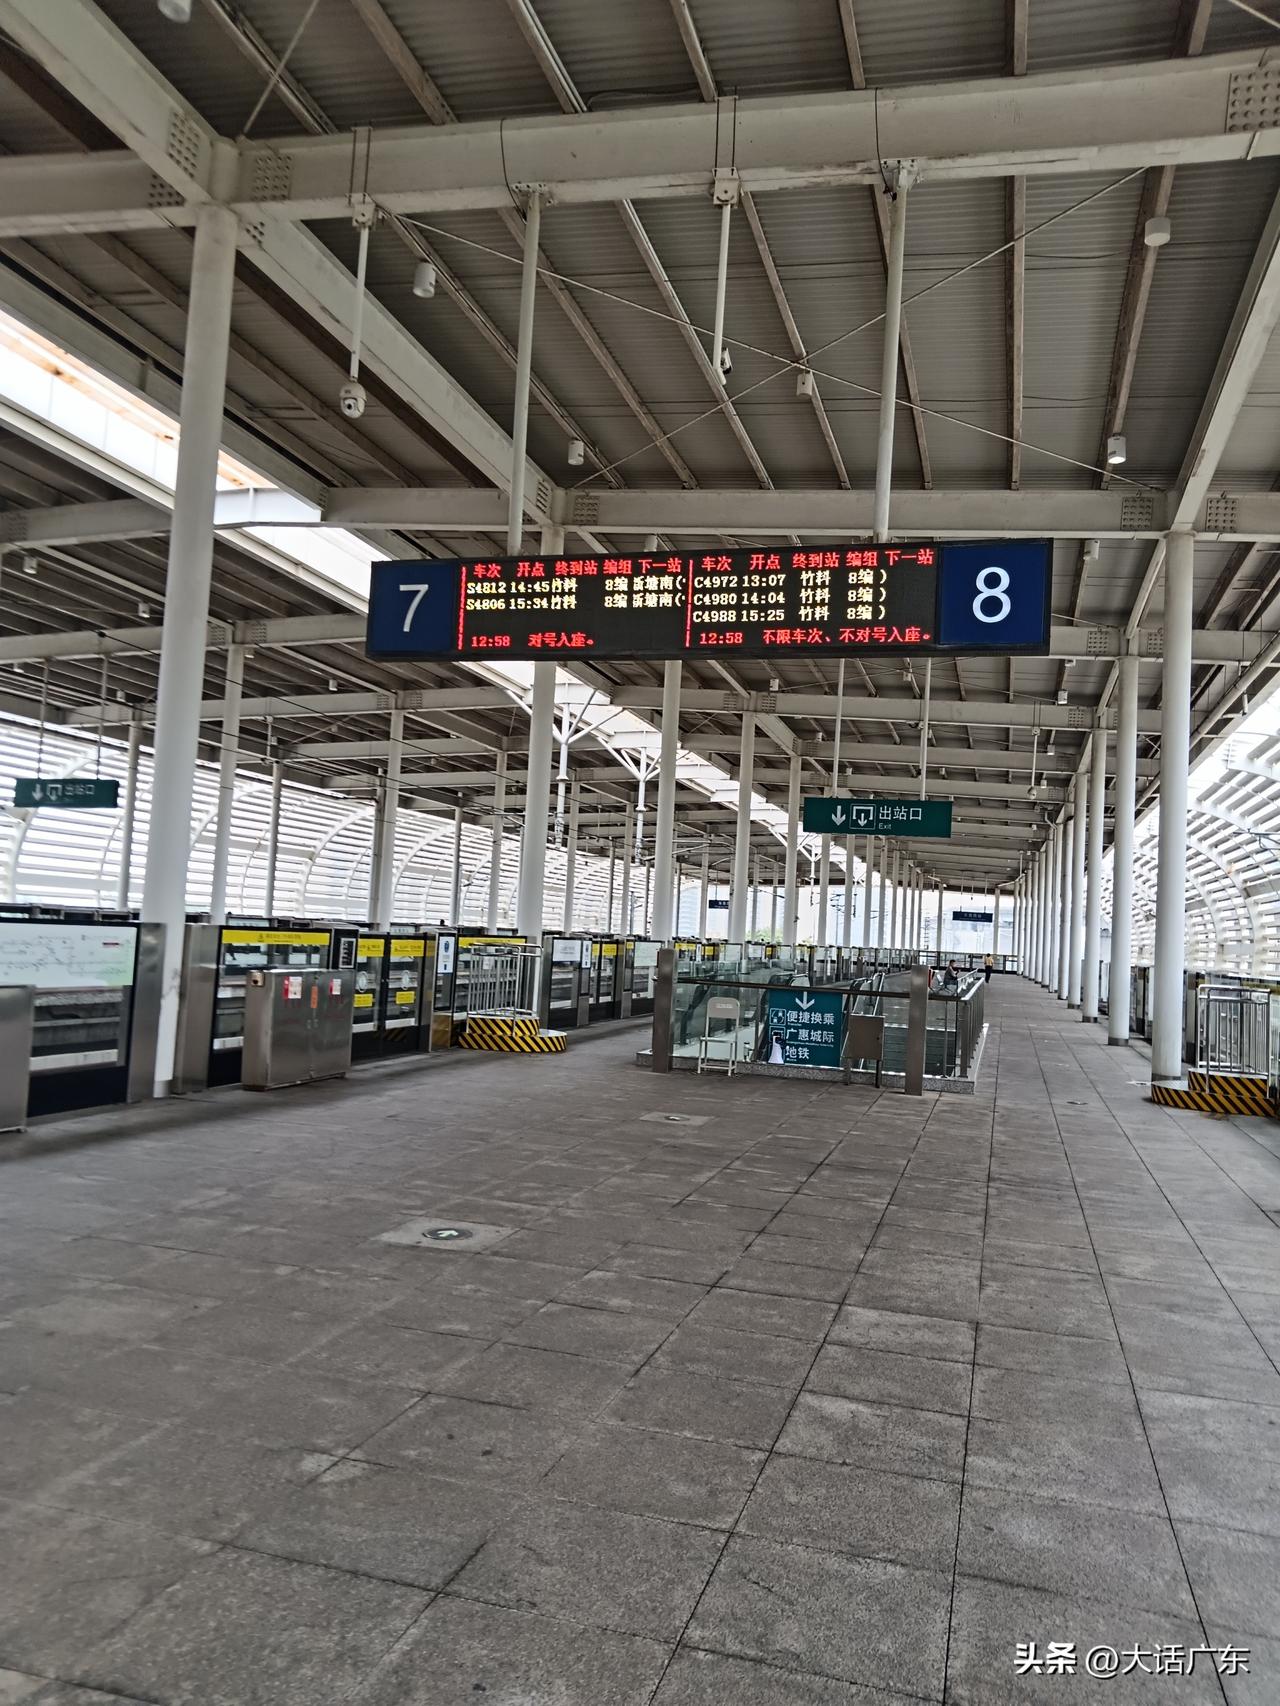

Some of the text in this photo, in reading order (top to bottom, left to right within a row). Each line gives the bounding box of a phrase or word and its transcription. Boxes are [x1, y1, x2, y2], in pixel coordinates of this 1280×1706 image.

[473, 558, 682, 578] 车次 开点 终到站 编组 下一站
[702, 549, 934, 571] 车次 开点 终到站 编组 下一站
[467, 582, 506, 594] S4812
[511, 581, 550, 593] 14:45
[605, 577, 628, 591] 8编
[694, 575, 737, 588] C4972
[742, 575, 785, 587] 13:07
[801, 570, 831, 586] 竹料
[848, 569, 873, 585] 8编
[466, 599, 506, 610] S4806
[604, 593, 628, 608] 8编
[694, 593, 737, 605] C4980
[741, 592, 785, 604] 14:04
[800, 587, 830, 603] 竹料
[848, 586, 873, 602] 8编
[972, 566, 1012, 624] 8
[399, 584, 429, 632] 7
[693, 610, 736, 623] C4988
[741, 610, 785, 622] 15:25
[799, 605, 830, 621] 竹料
[847, 604, 872, 620] 8编
[471, 632, 594, 648] 12:58 对号入座。
[700, 627, 931, 645] 12:58 不限车次、不对号入座。
[879, 805, 922, 821] 出站口
[787, 1010, 834, 1025] 便捷换乘
[786, 1028, 834, 1043] 广惠城际
[786, 1046, 810, 1060] 地铁
